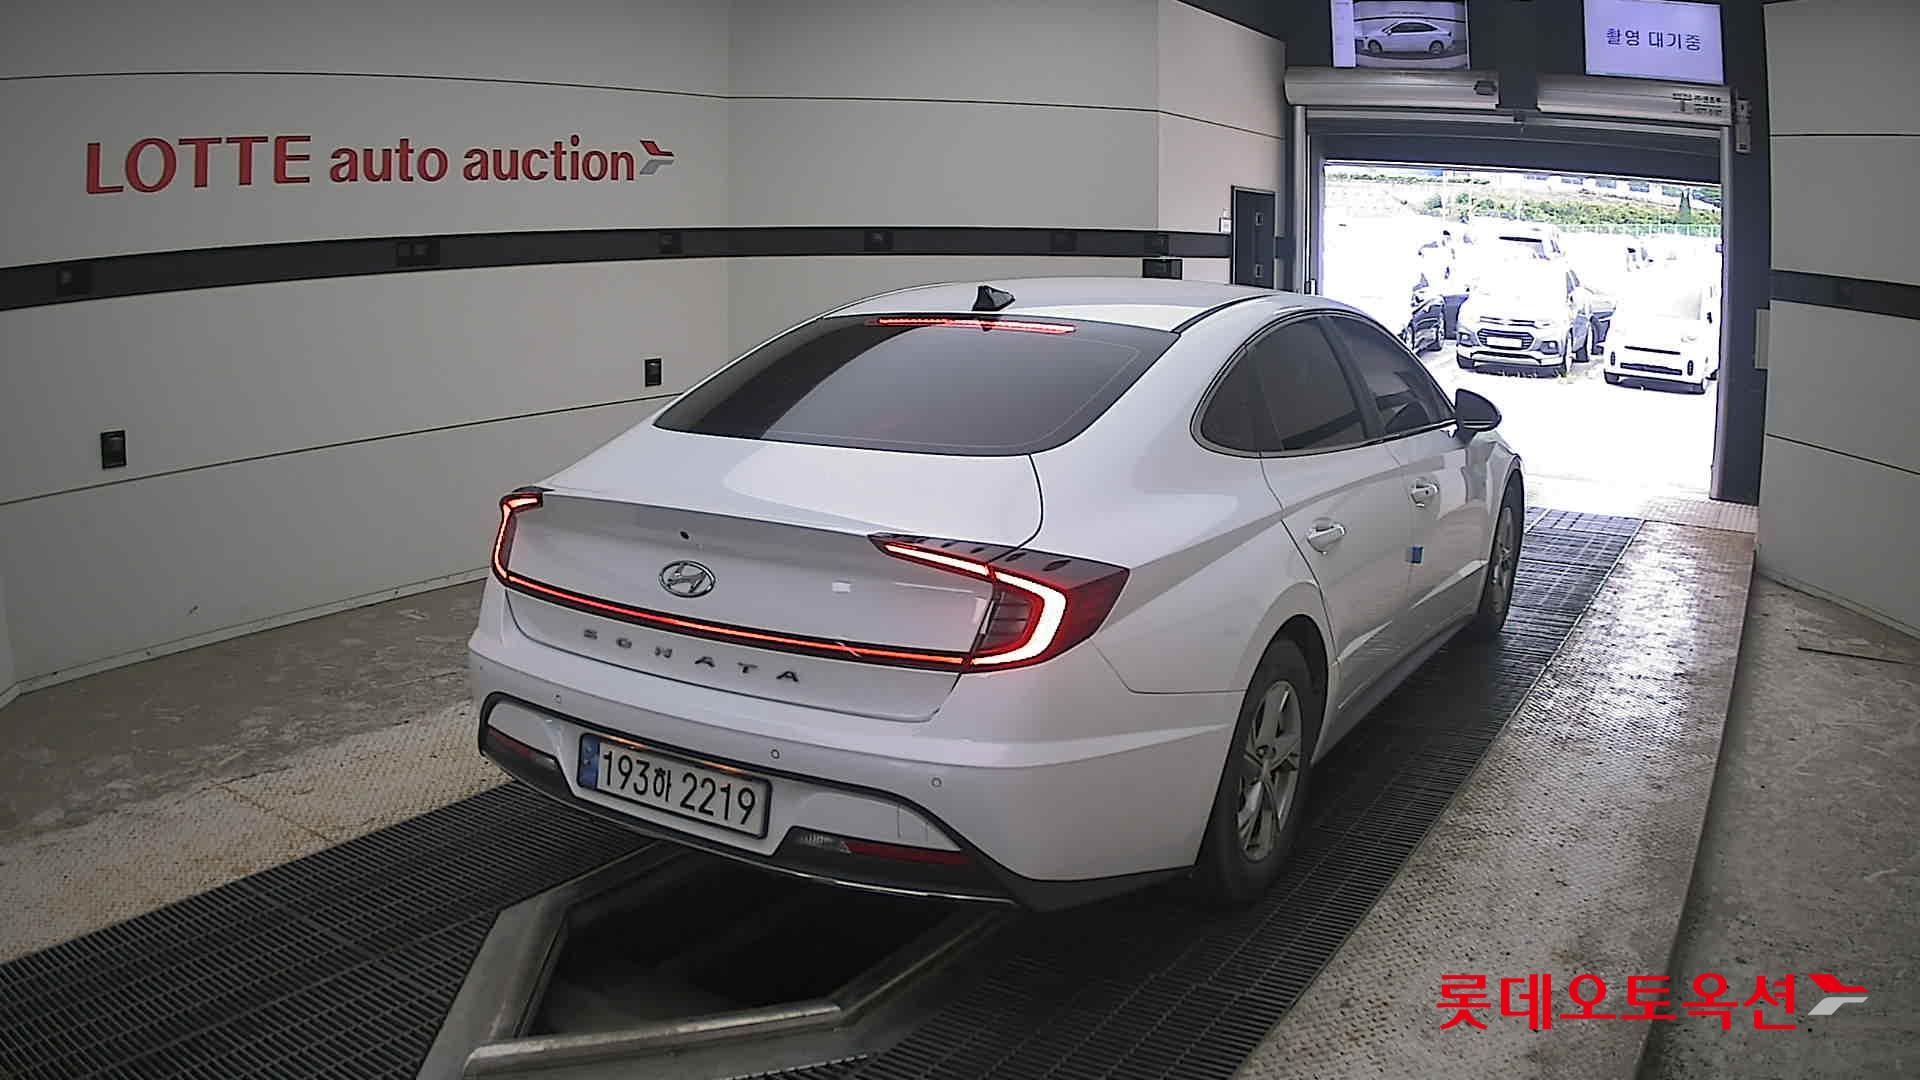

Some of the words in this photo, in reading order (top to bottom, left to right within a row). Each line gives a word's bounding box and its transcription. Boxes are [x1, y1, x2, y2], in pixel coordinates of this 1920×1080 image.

[1606, 28, 1640, 47] 촬영
[1648, 31, 1702, 51] 대기중
[86, 135, 312, 195] LOTTE
[329, 138, 449, 184] auto
[462, 134, 635, 183] auction
[583, 628, 800, 683] SONATA
[603, 750, 672, 803] 193하
[679, 772, 757, 826] 2219
